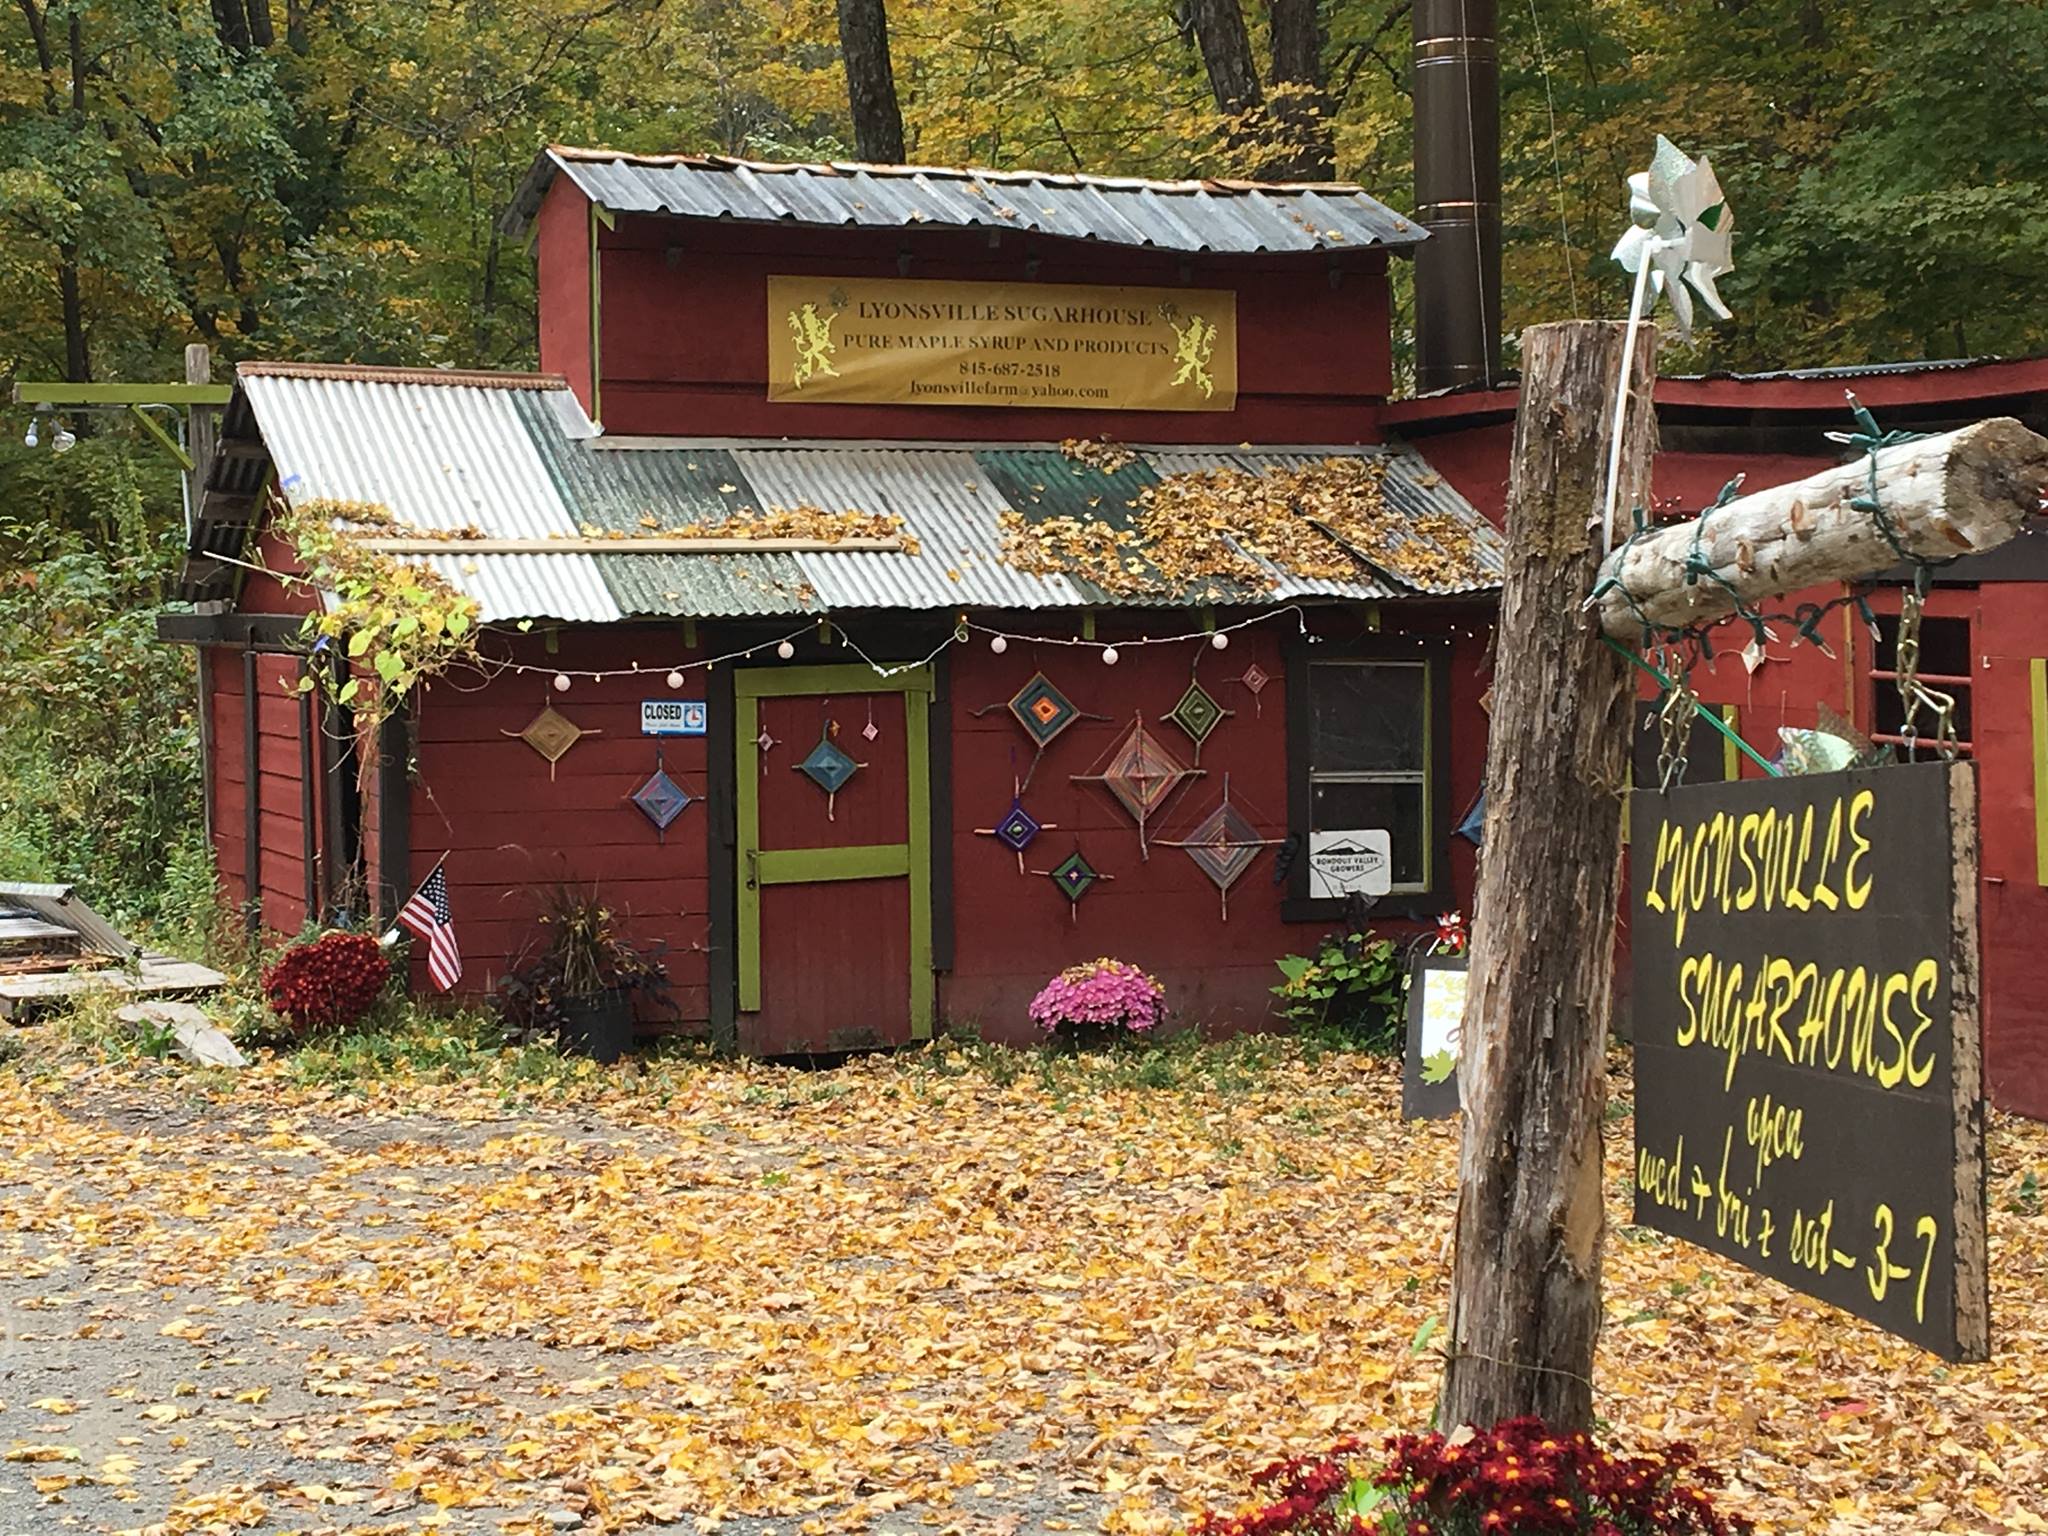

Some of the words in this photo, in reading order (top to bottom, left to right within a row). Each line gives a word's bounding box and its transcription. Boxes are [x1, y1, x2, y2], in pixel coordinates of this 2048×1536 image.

[858, 301, 999, 321] LYONSVILLE
[1004, 305, 1153, 327] SUGARHOUSE
[843, 333, 893, 350] PURE
[899, 334, 964, 351] MAPLE
[968, 335, 1027, 352] SYRUP
[1031, 337, 1069, 353] AND
[1073, 338, 1169, 357] PRODUCTS
[959, 361, 1061, 379] 845-687-2518
[910, 379, 1109, 400] lyonsvillefarm@yahoo.com
[644, 704, 682, 720] CLOSED
[1354, 856, 1378, 864] VALLEY
[1646, 789, 1875, 949] LYONSVILLE
[1676, 953, 1939, 1092] SUGARHOUSE
[1747, 1093, 1804, 1189] open
[1638, 1134, 1688, 1211] wed.
[1716, 1125, 1752, 1248] fri
[1866, 1203, 1938, 1324] 3-7
